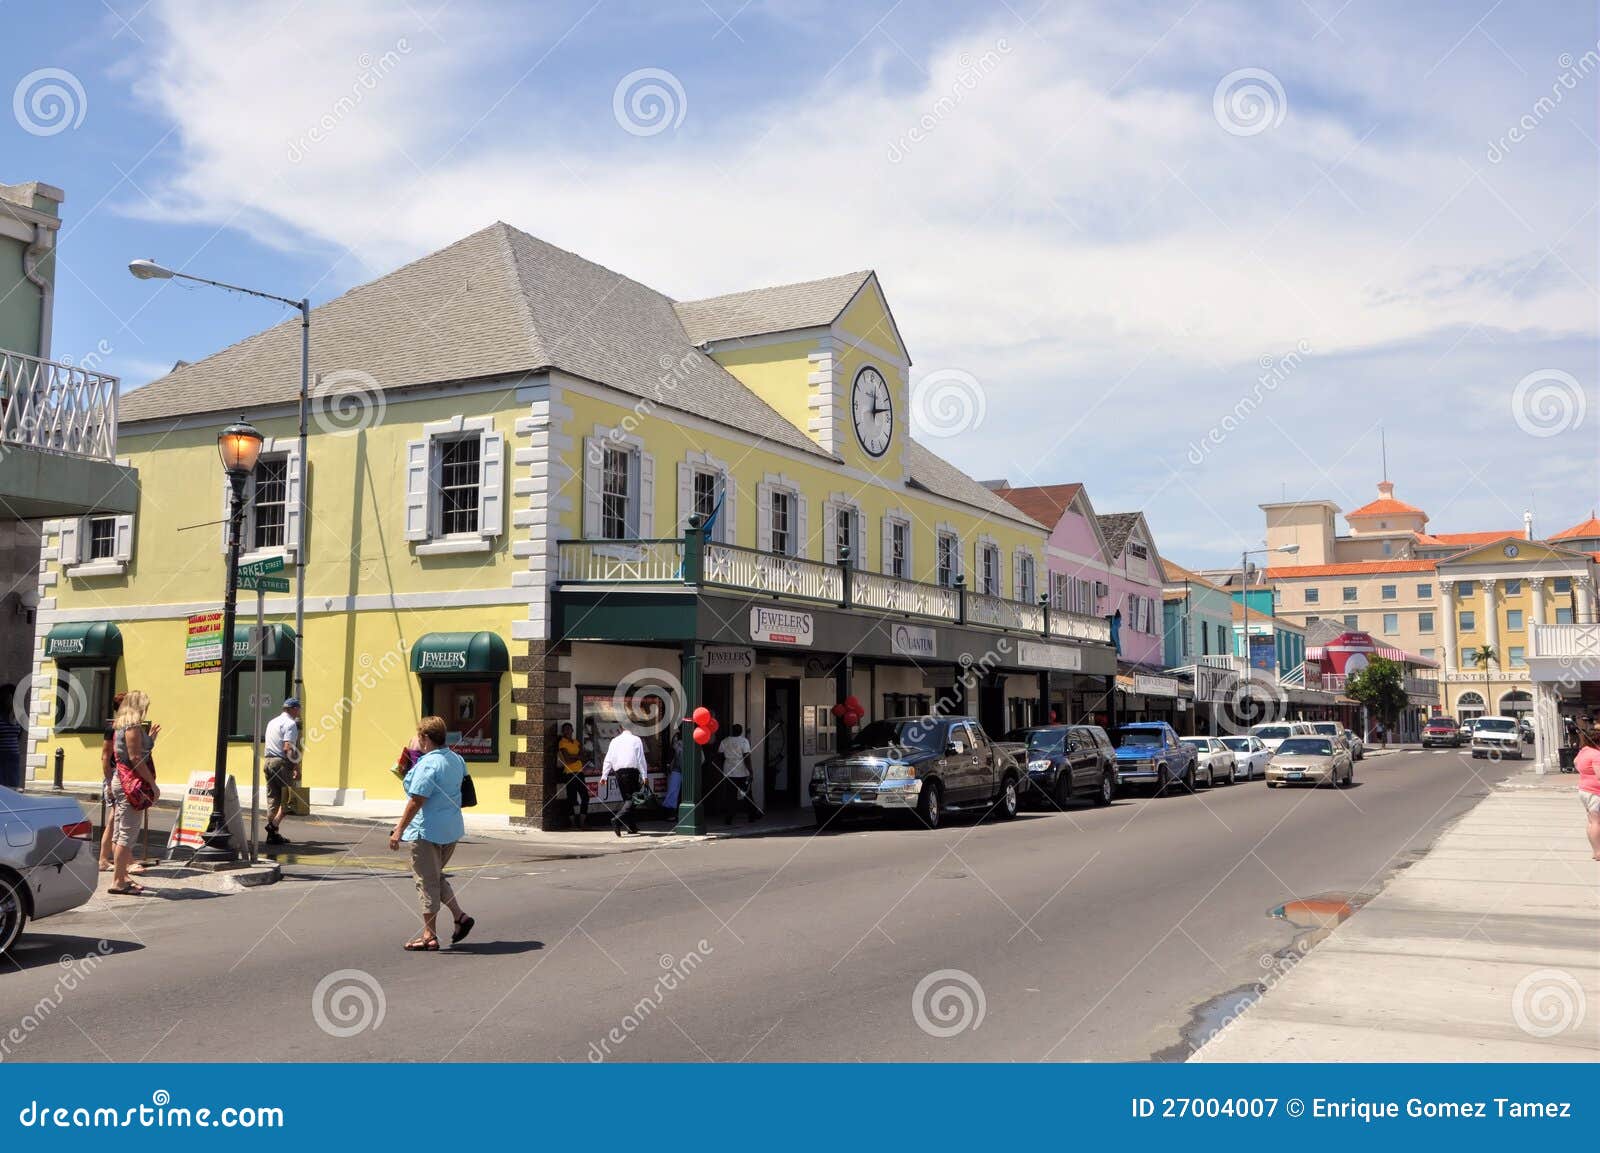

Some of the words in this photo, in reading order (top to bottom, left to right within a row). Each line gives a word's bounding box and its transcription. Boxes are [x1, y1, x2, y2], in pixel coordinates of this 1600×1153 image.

[237, 562, 265, 576] ARKET
[265, 560, 281, 570] STREET
[236, 577, 260, 589] BAY
[263, 581, 289, 589] STREET
[1447, 673, 1492, 681] CENTRE
